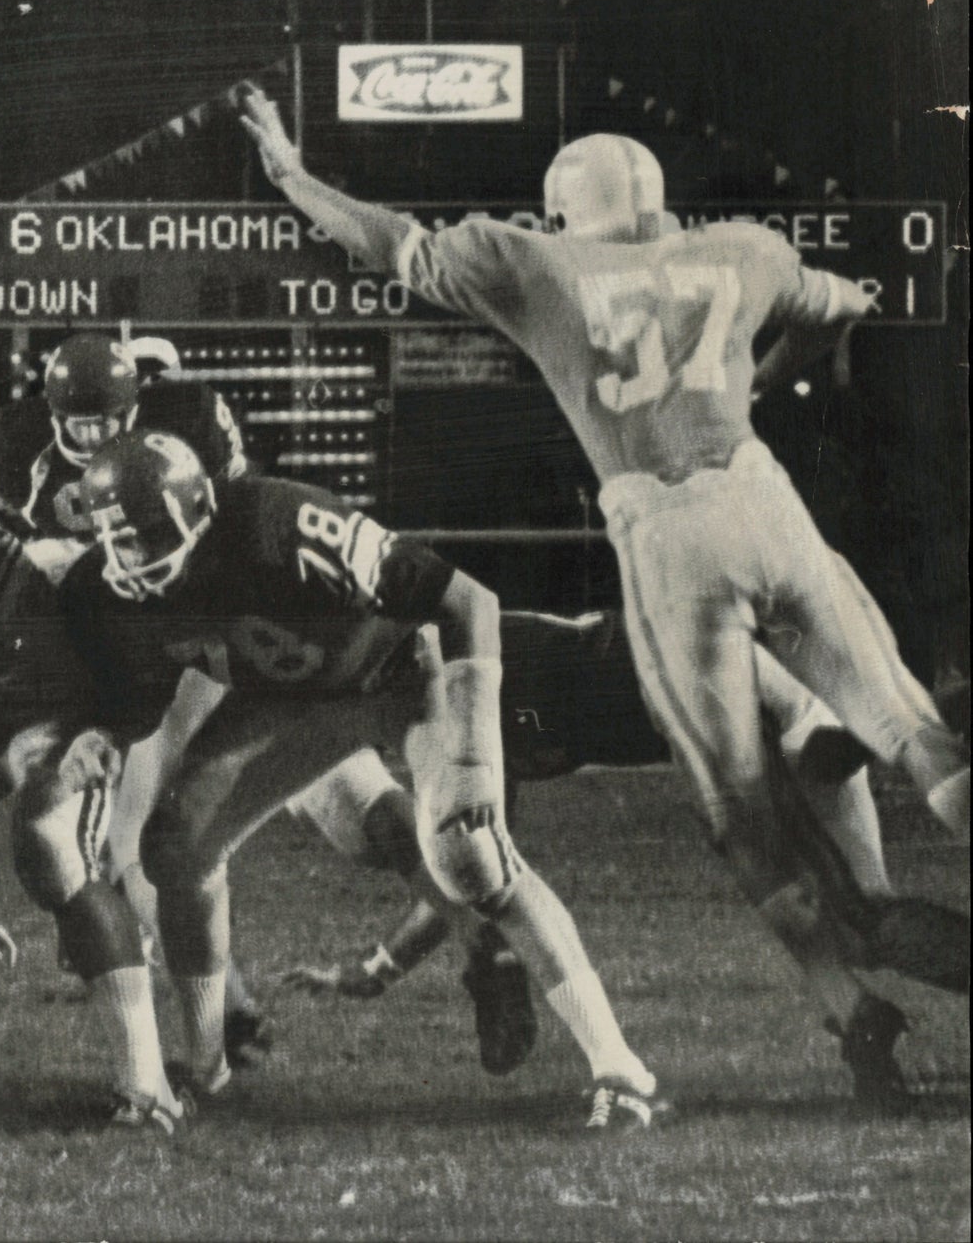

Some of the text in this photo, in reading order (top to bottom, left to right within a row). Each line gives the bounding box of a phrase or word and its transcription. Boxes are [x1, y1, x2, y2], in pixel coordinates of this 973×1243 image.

[10, 212, 43, 255] 6
[55, 214, 300, 251] OKLAHOMA
[902, 211, 934, 253] 0
[279, 279, 338, 316] TO
[351, 279, 410, 316] GO
[577, 264, 741, 414] 57
